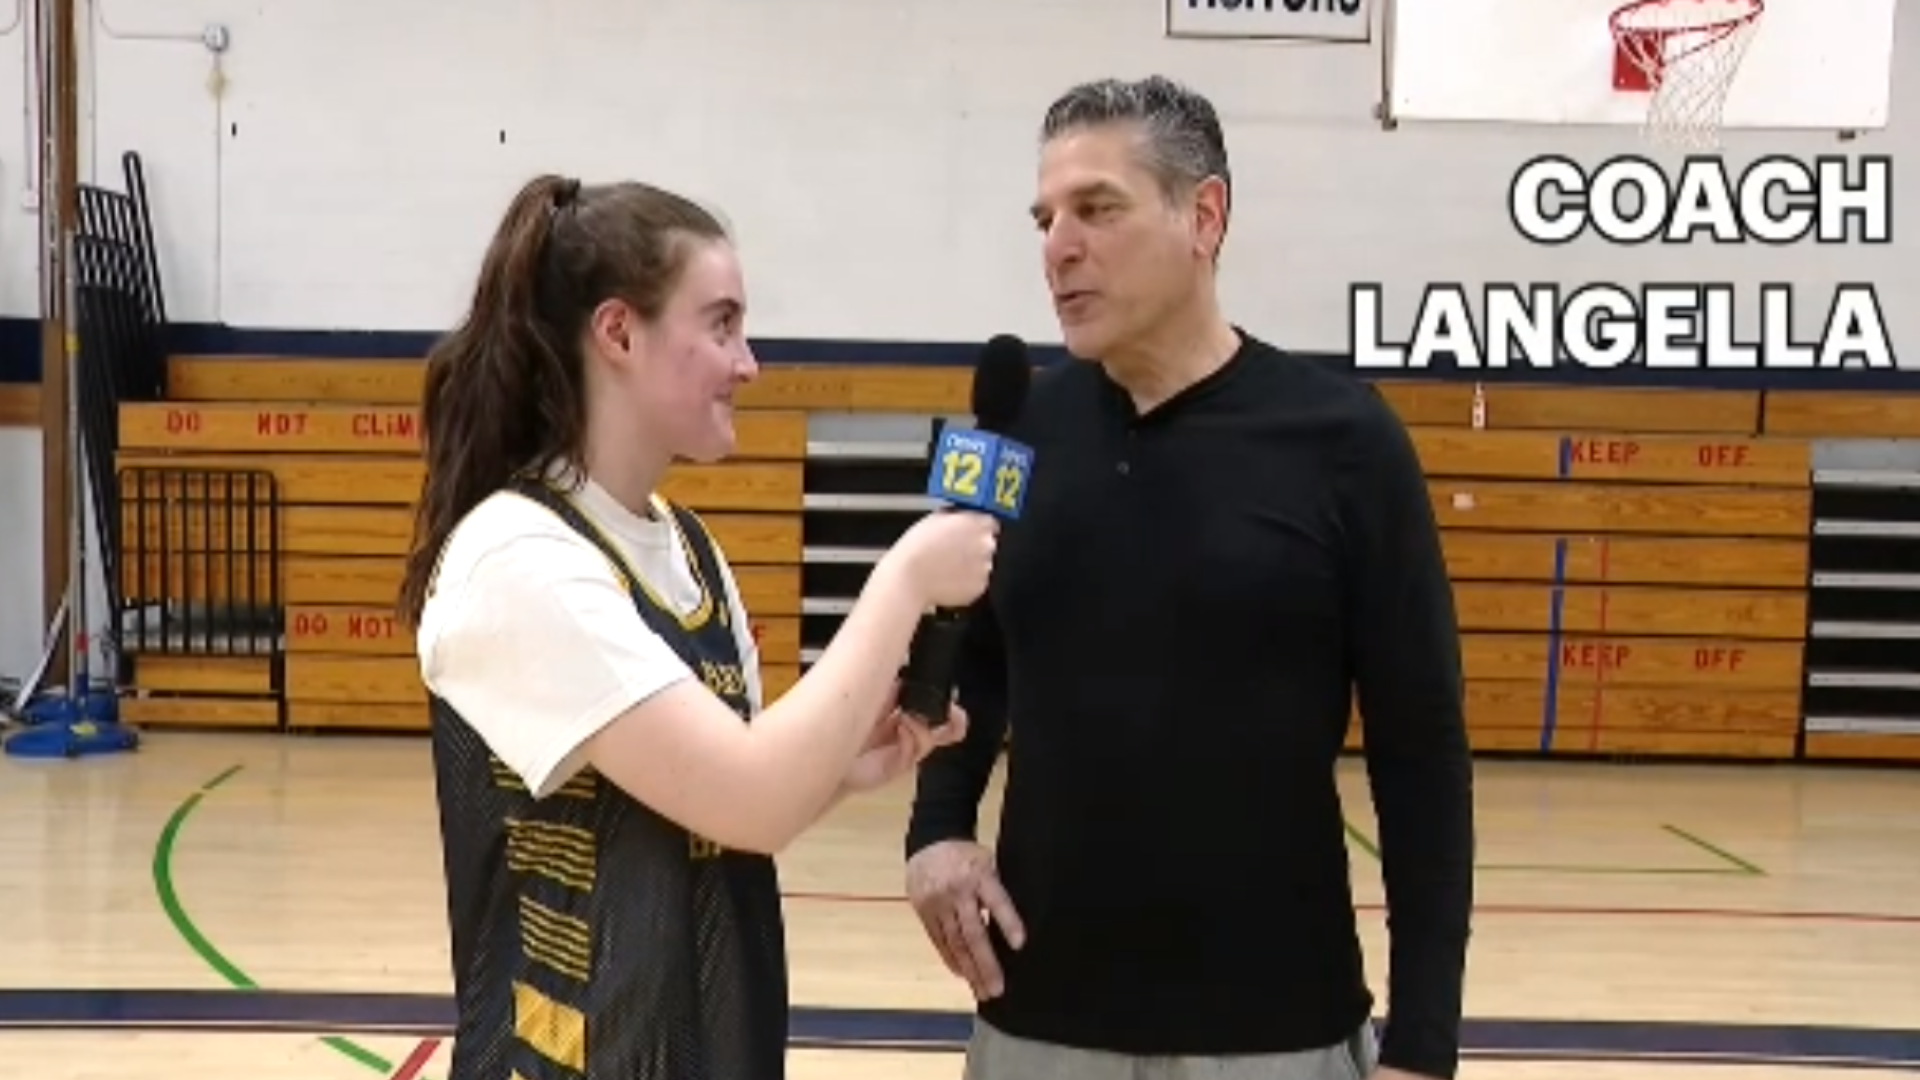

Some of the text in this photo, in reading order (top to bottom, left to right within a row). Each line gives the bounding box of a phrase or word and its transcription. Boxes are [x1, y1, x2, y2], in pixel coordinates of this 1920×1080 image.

[165, 410, 202, 434] DO
[257, 412, 309, 437] NOT
[1570, 440, 1751, 468] KEEP OFF
[942, 450, 982, 496] 12
[995, 465, 1022, 510] 12
[293, 613, 398, 639] DO NOT
[1562, 643, 1746, 672] KEEP OFF
